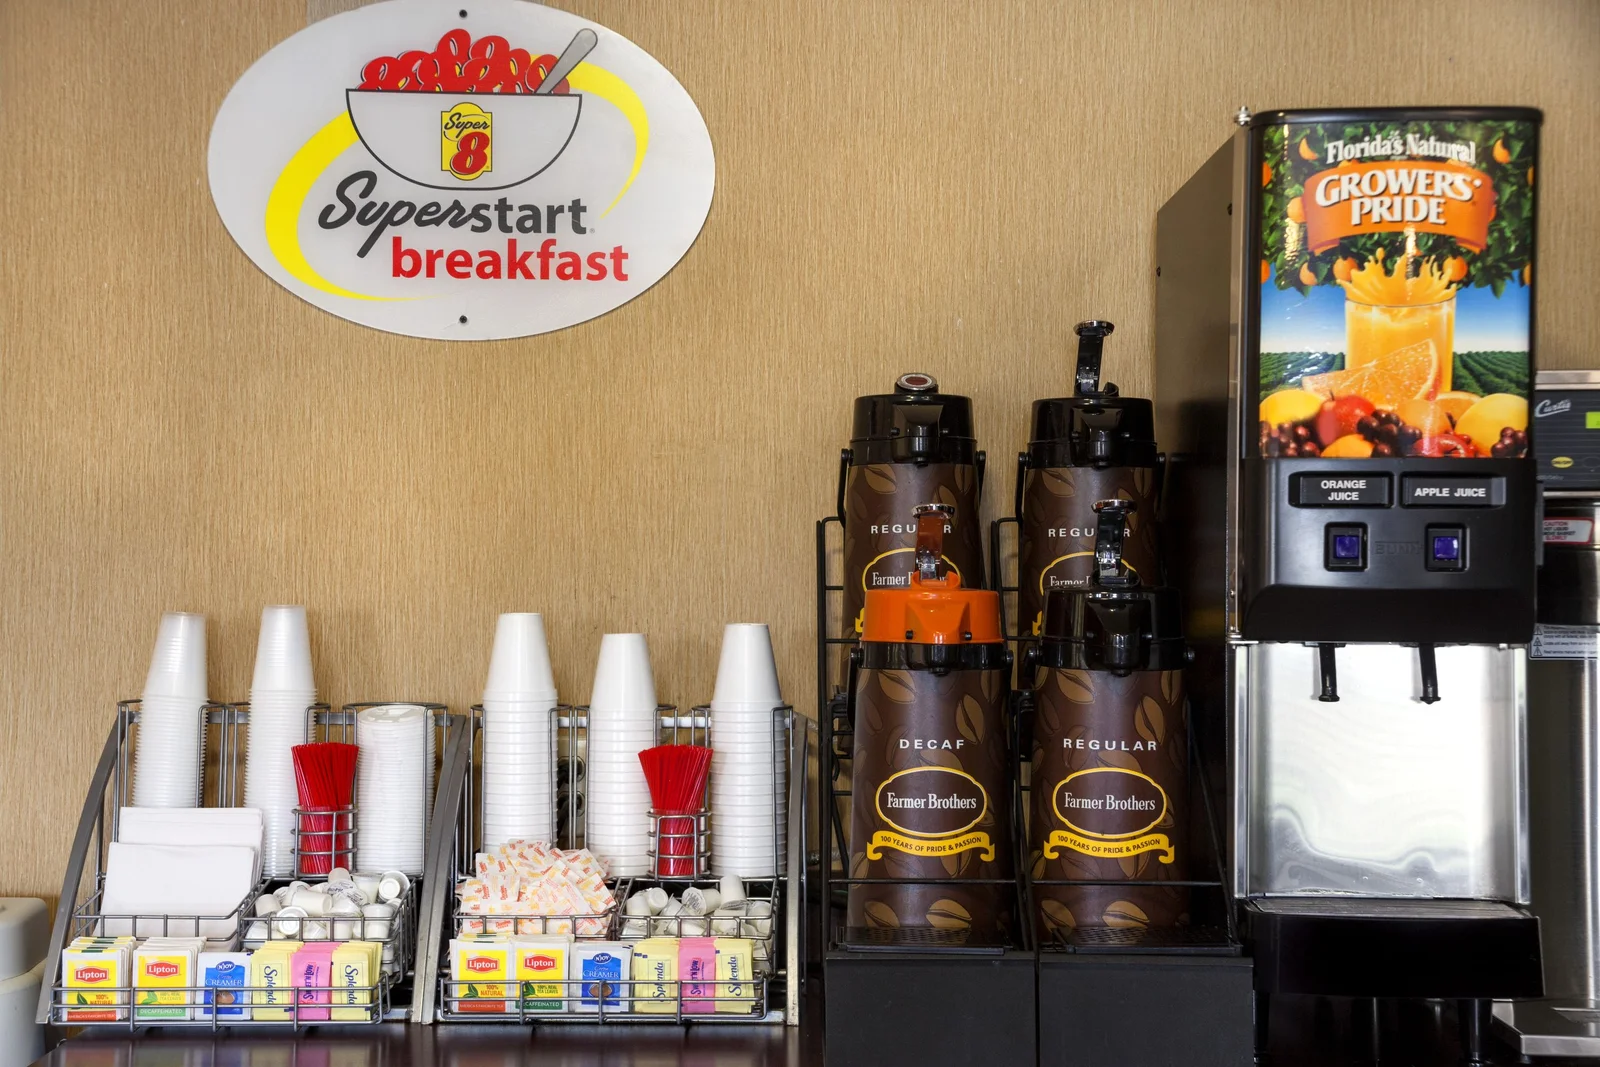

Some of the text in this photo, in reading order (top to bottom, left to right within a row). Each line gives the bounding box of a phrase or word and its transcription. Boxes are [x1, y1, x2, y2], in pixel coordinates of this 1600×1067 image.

[444, 112, 490, 139] Super
[449, 131, 490, 175] 8
[1326, 132, 1476, 164] Florida's Natural
[318, 170, 587, 259] Superstart
[1351, 196, 1446, 226] PRIDE
[391, 236, 629, 282] breakfast
[1320, 480, 1367, 489] ORANGE
[1327, 492, 1359, 501] JUICE
[1414, 487, 1486, 497] APPLE JUICE
[871, 524, 951, 534] REGUR
[1048, 528, 1130, 537] REGUR
[872, 572, 905, 586] Farmer
[900, 738, 965, 750] DECAF
[1063, 738, 1158, 751] REGULAR
[887, 792, 977, 810] Farmer Brothers
[1064, 792, 1156, 811] Farmer Brothers
[881, 835, 891, 843] 100
[893, 839, 913, 850] YEARS
[915, 844, 924, 852] OF
[955, 837, 982, 849] PASSION
[1057, 835, 1068, 843] 100
[1069, 839, 1090, 851] YEARS
[1132, 838, 1161, 851] PASSION
[469, 960, 496, 969] Lipton
[526, 958, 553, 967] Lipton
[77, 971, 106, 980] Lipton
[148, 965, 176, 974] Lipton
[582, 970, 619, 978] CREAMER
[205, 978, 243, 987] CREAMER
[652, 962, 666, 1002] Splnda
